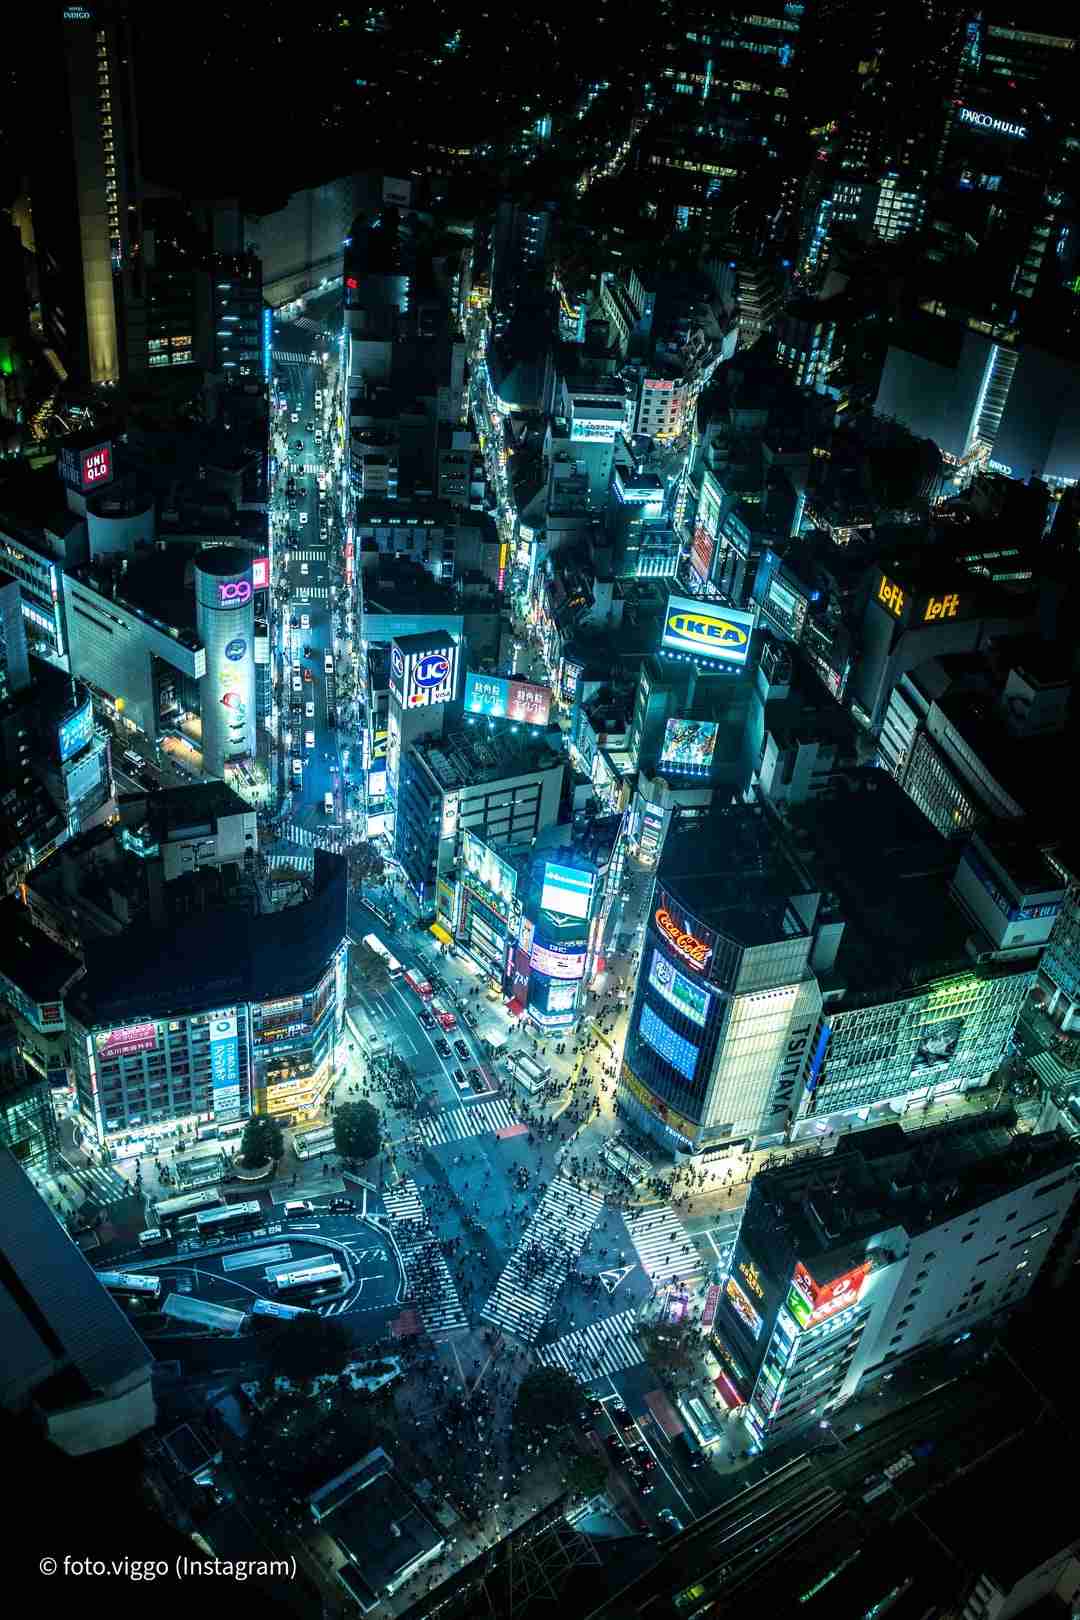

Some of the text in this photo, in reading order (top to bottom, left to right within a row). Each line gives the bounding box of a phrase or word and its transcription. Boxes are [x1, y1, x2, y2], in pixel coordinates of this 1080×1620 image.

[993, 120, 1027, 137] HULIC
[87, 453, 105, 468] UNI
[88, 464, 107, 480] QLO
[219, 581, 251, 602] 109
[675, 617, 740, 643] IKEA
[416, 661, 448, 681] UC
[769, 1023, 812, 1116] TSUTAYA
